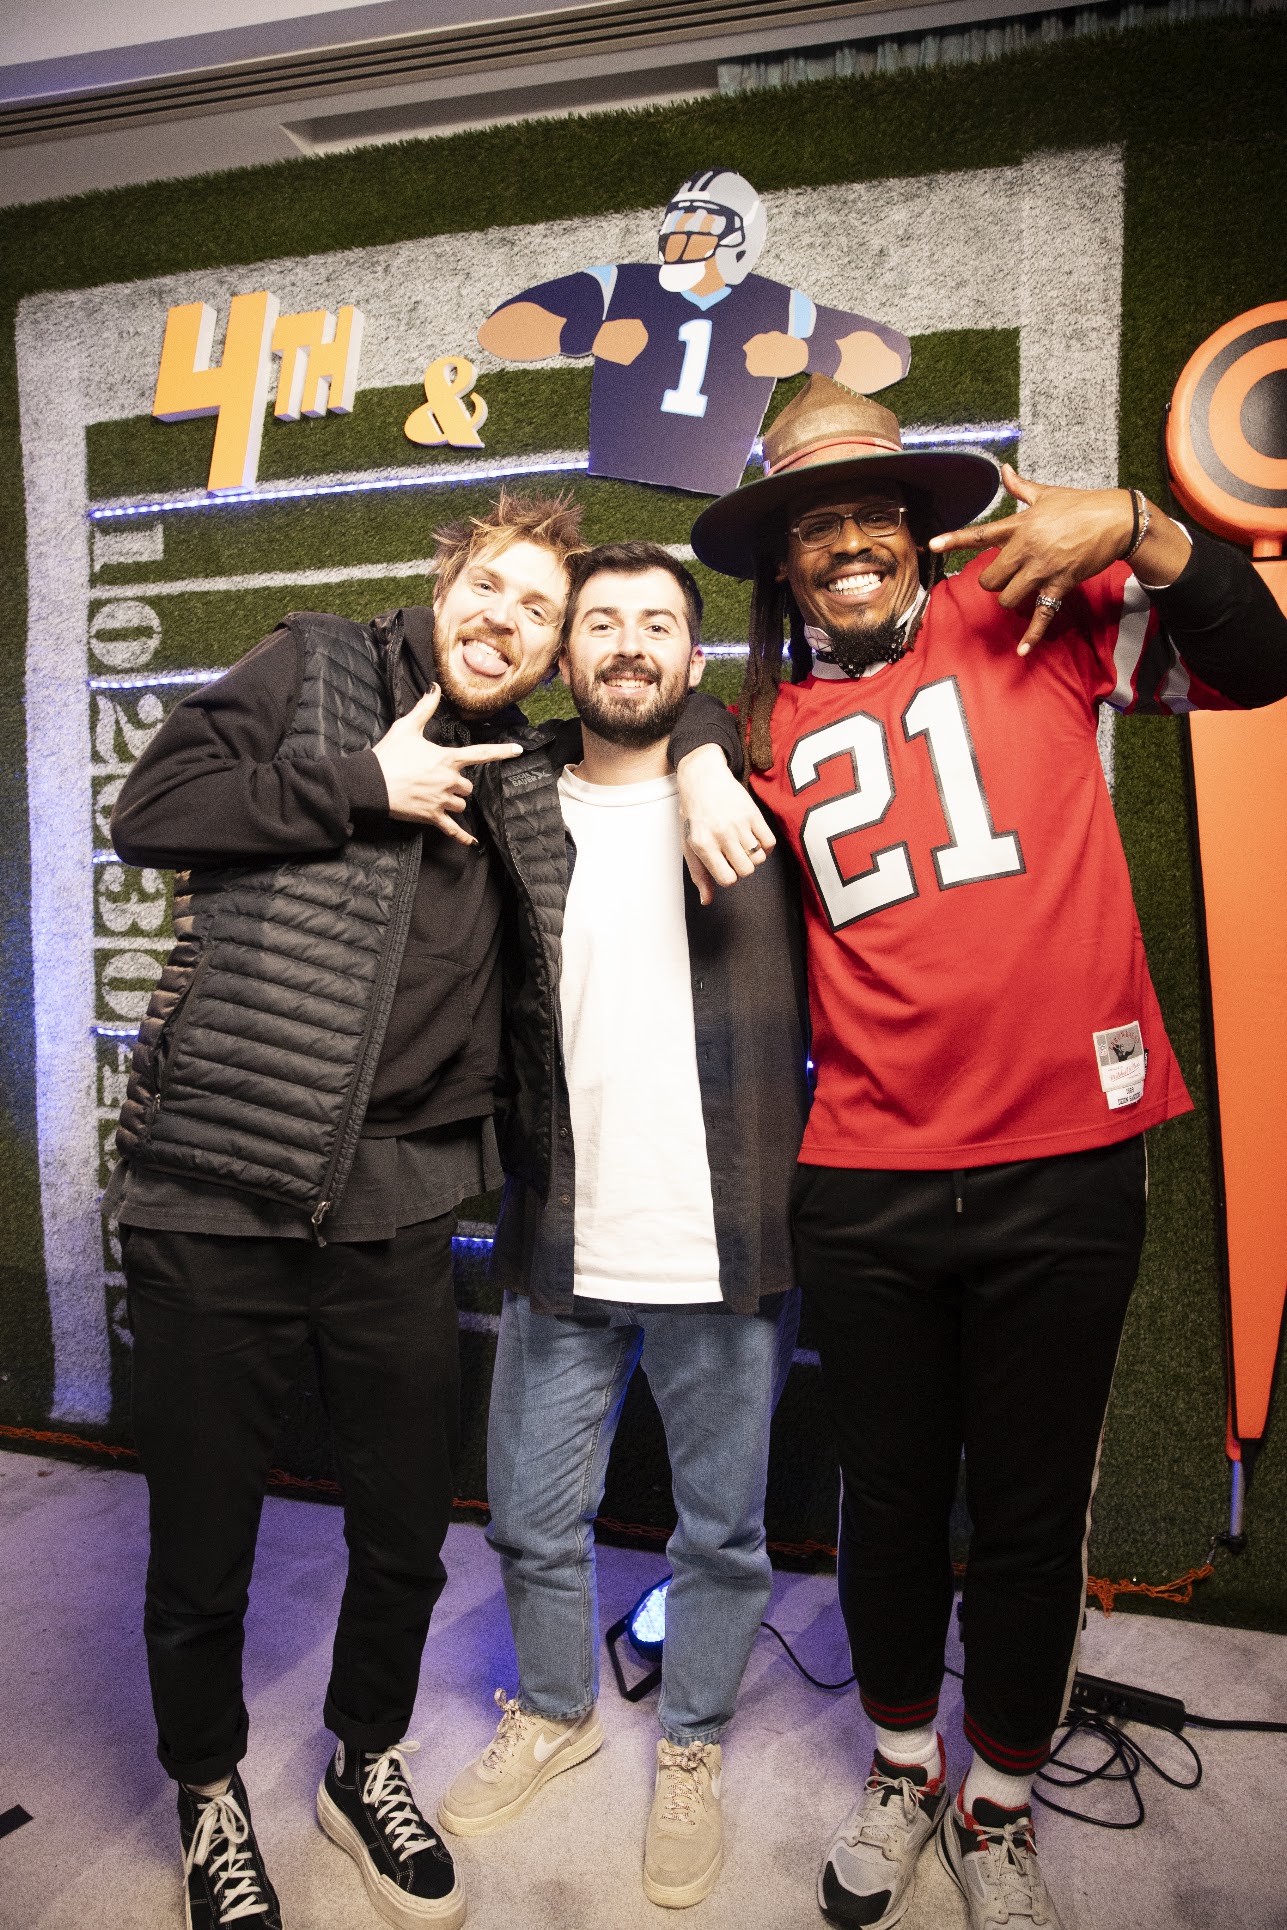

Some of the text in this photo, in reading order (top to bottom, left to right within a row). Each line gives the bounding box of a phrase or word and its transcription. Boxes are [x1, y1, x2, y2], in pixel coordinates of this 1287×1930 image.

[152, 291, 712, 497] 4TH & 1
[89, 520, 164, 669] 10
[512, 775, 537, 787] BAUER
[786, 675, 1026, 932] 21
